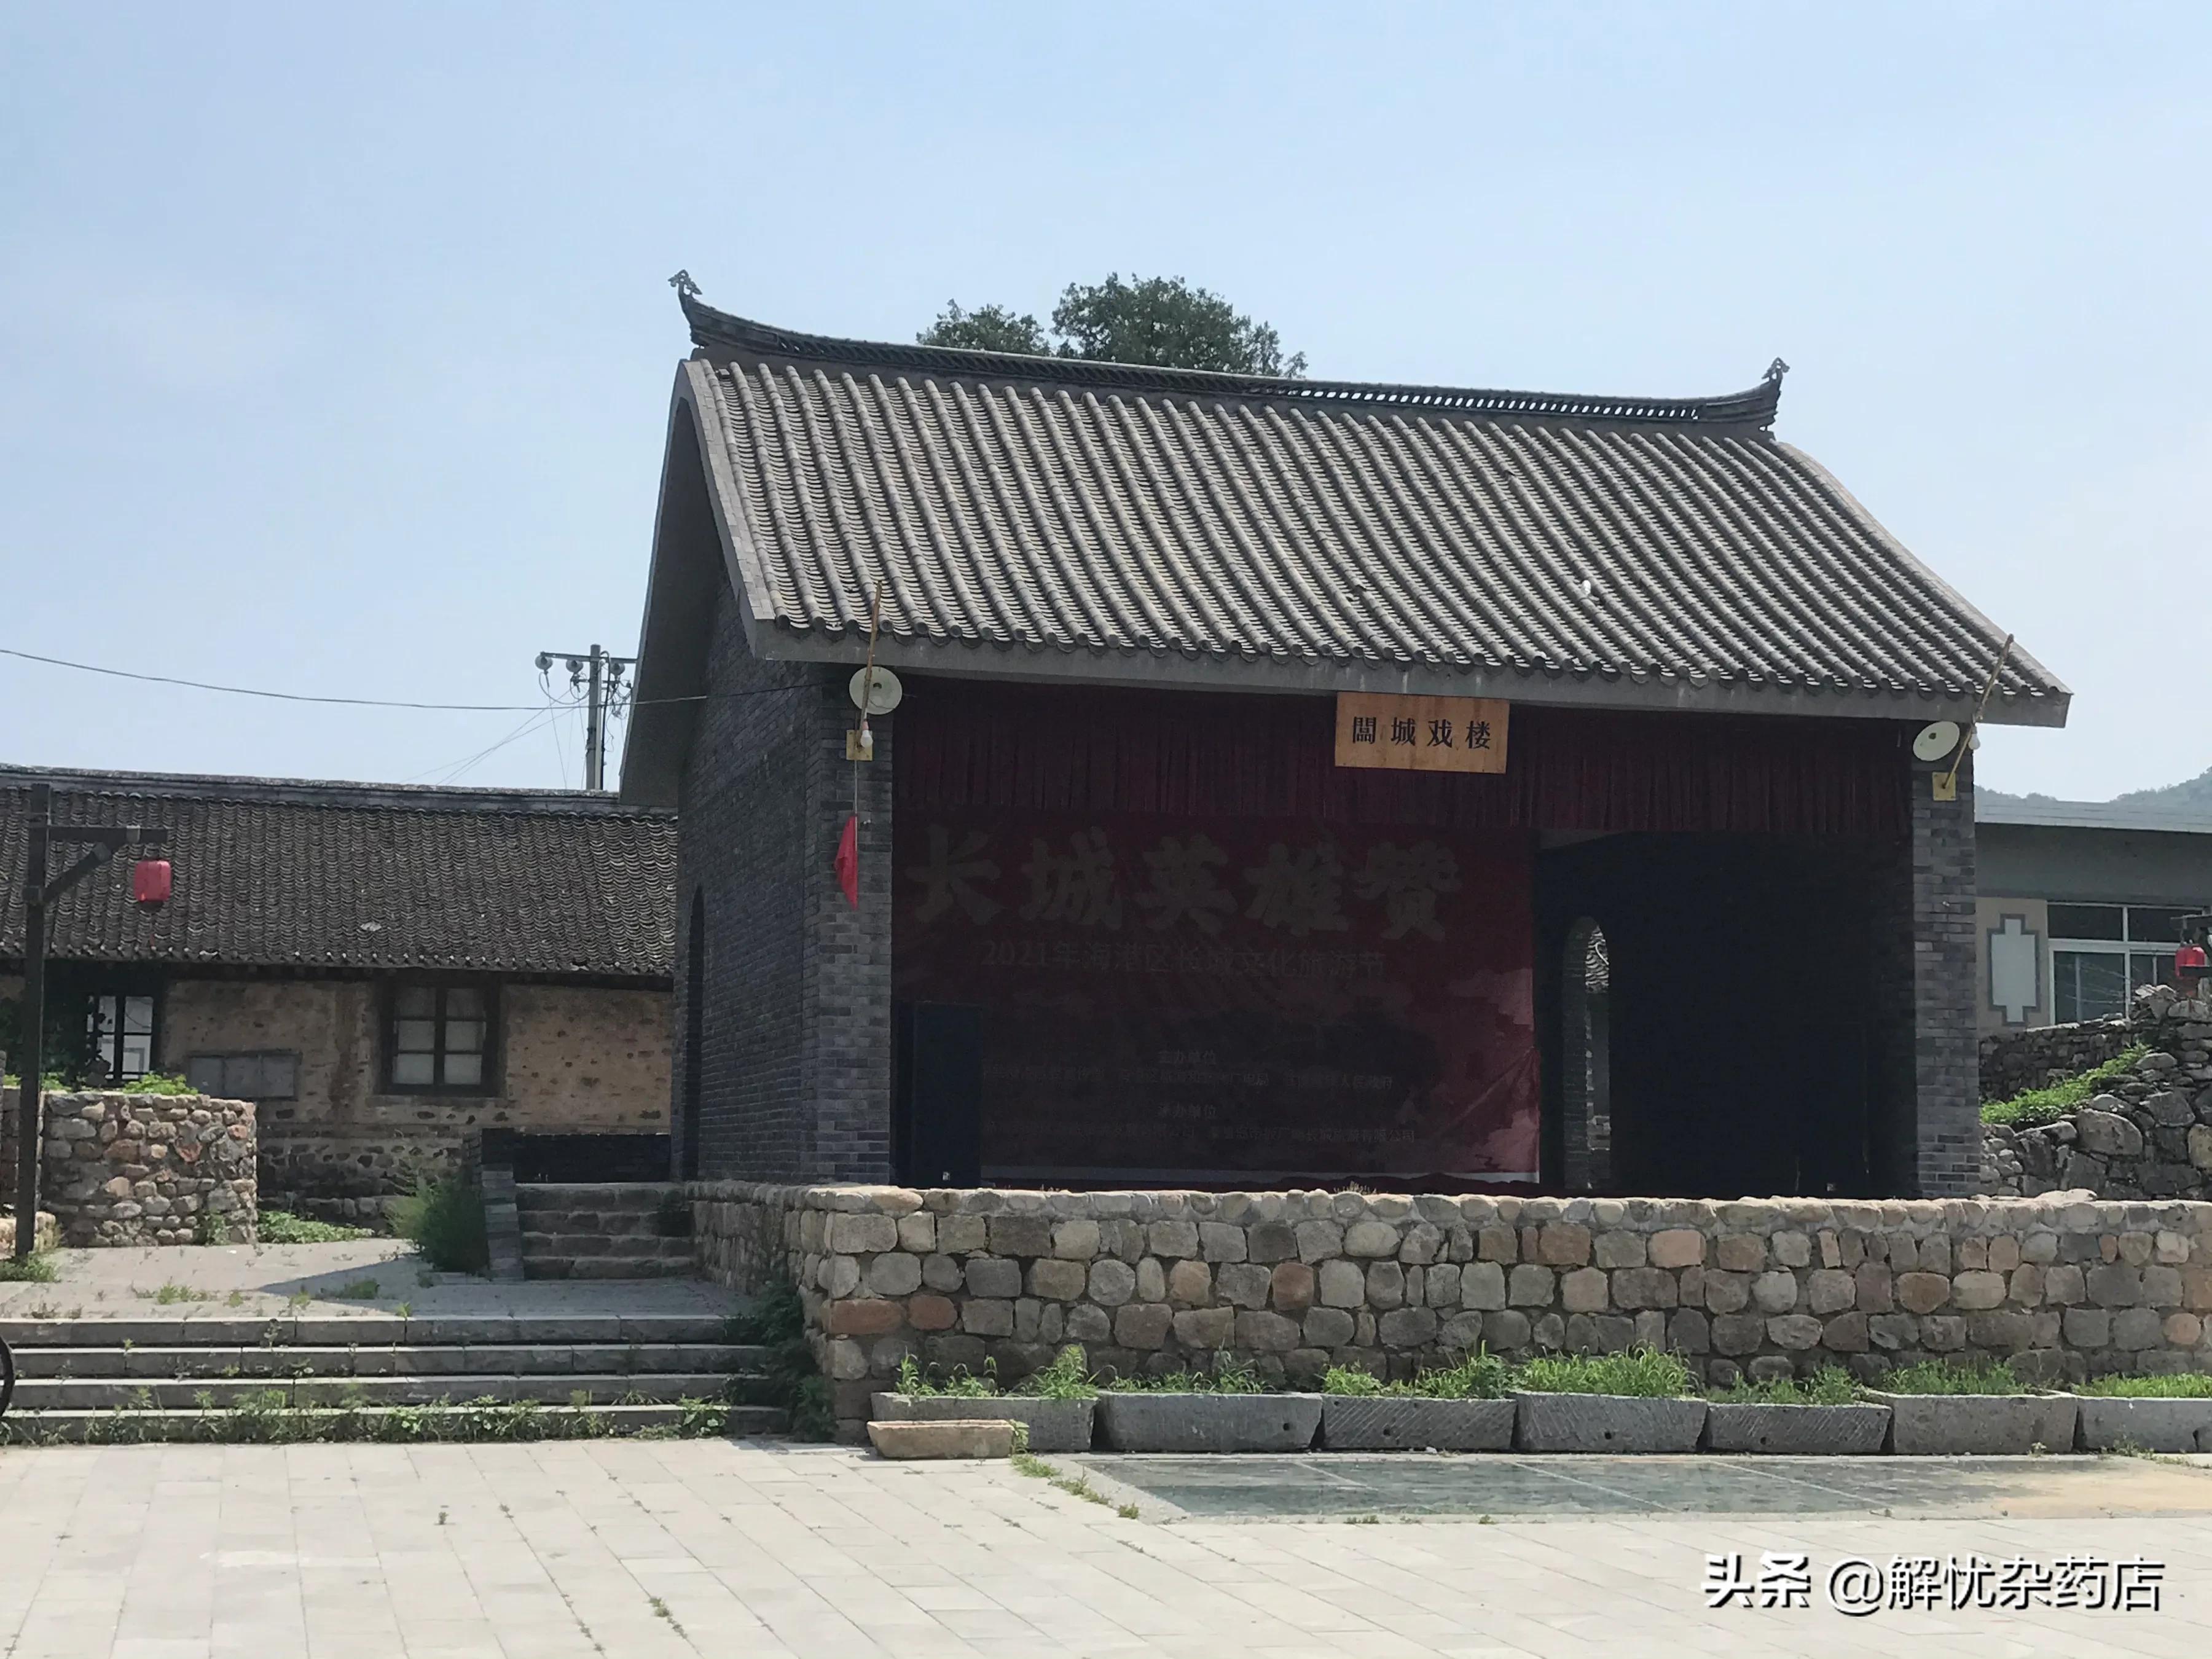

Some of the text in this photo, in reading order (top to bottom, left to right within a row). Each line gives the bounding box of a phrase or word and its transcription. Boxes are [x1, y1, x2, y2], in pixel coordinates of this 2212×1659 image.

[904, 822, 1462, 941] 长城英雄赞
